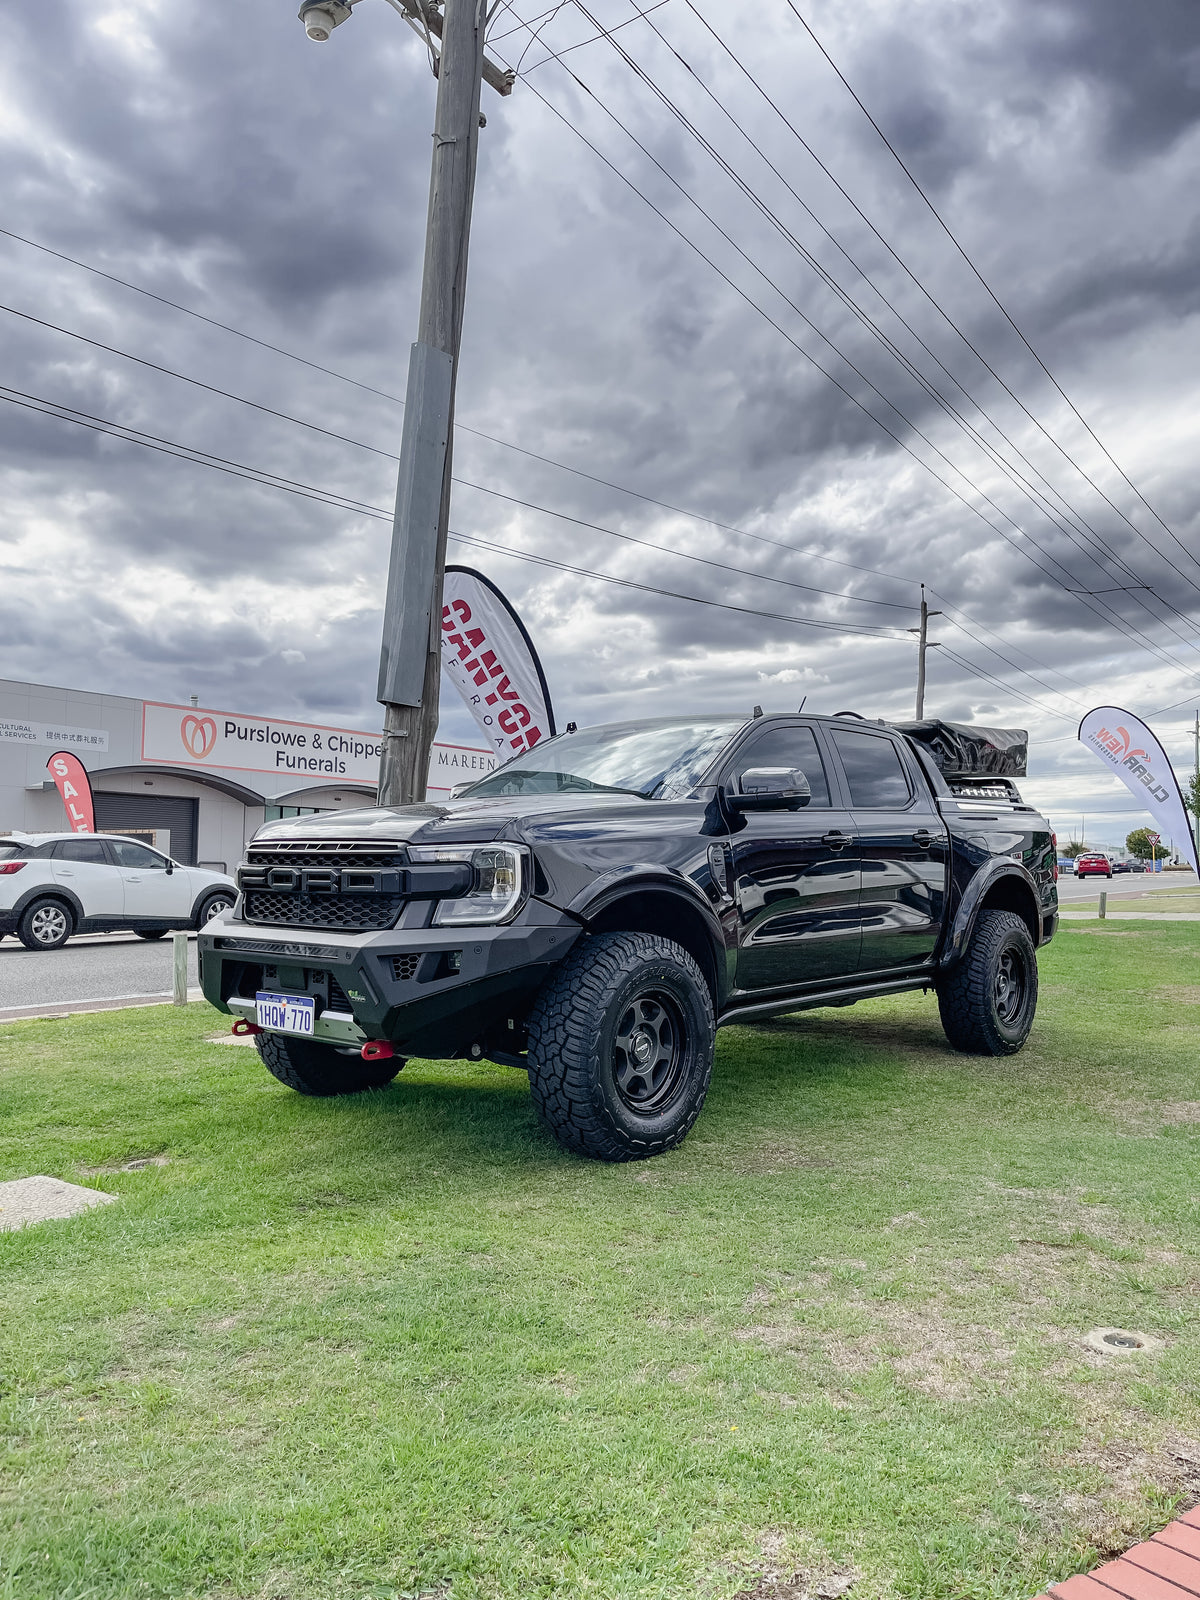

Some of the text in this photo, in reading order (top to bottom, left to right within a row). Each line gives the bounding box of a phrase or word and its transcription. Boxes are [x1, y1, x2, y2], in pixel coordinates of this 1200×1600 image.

[4, 731, 37, 740] SERVICES
[224, 721, 382, 759] Purslowe & Chippe
[275, 750, 346, 774] Funerals
[437, 752, 496, 771] MAREEN
[237, 865, 383, 893] FORD
